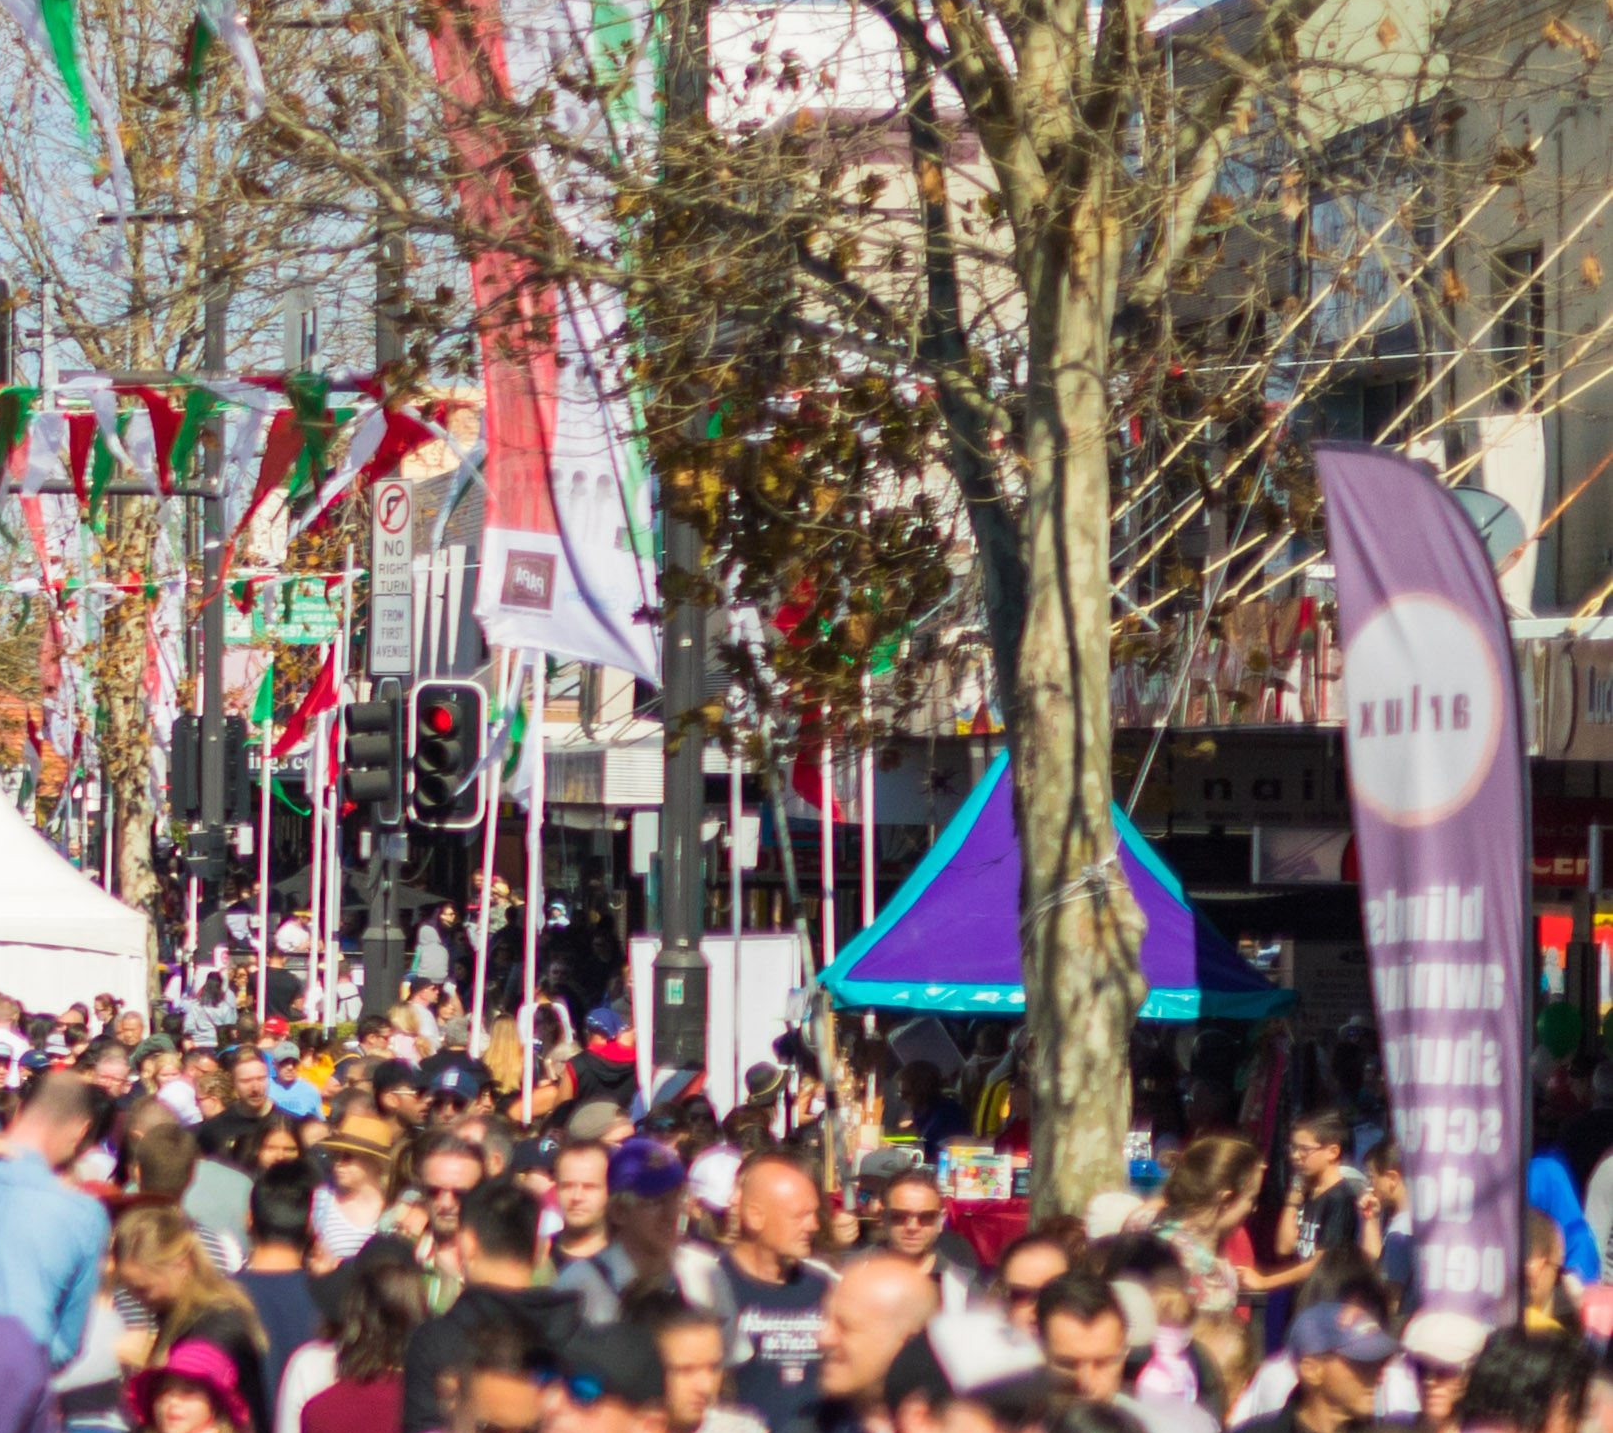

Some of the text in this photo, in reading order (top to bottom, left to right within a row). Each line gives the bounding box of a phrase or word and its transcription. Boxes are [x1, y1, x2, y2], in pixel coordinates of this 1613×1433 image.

[383, 540, 405, 557] NO
[378, 563, 409, 575] RIGHT
[379, 580, 408, 592] TURN
[381, 609, 404, 622] FROM
[381, 627, 404, 639] FIRST
[376, 645, 409, 658] AVENUE
